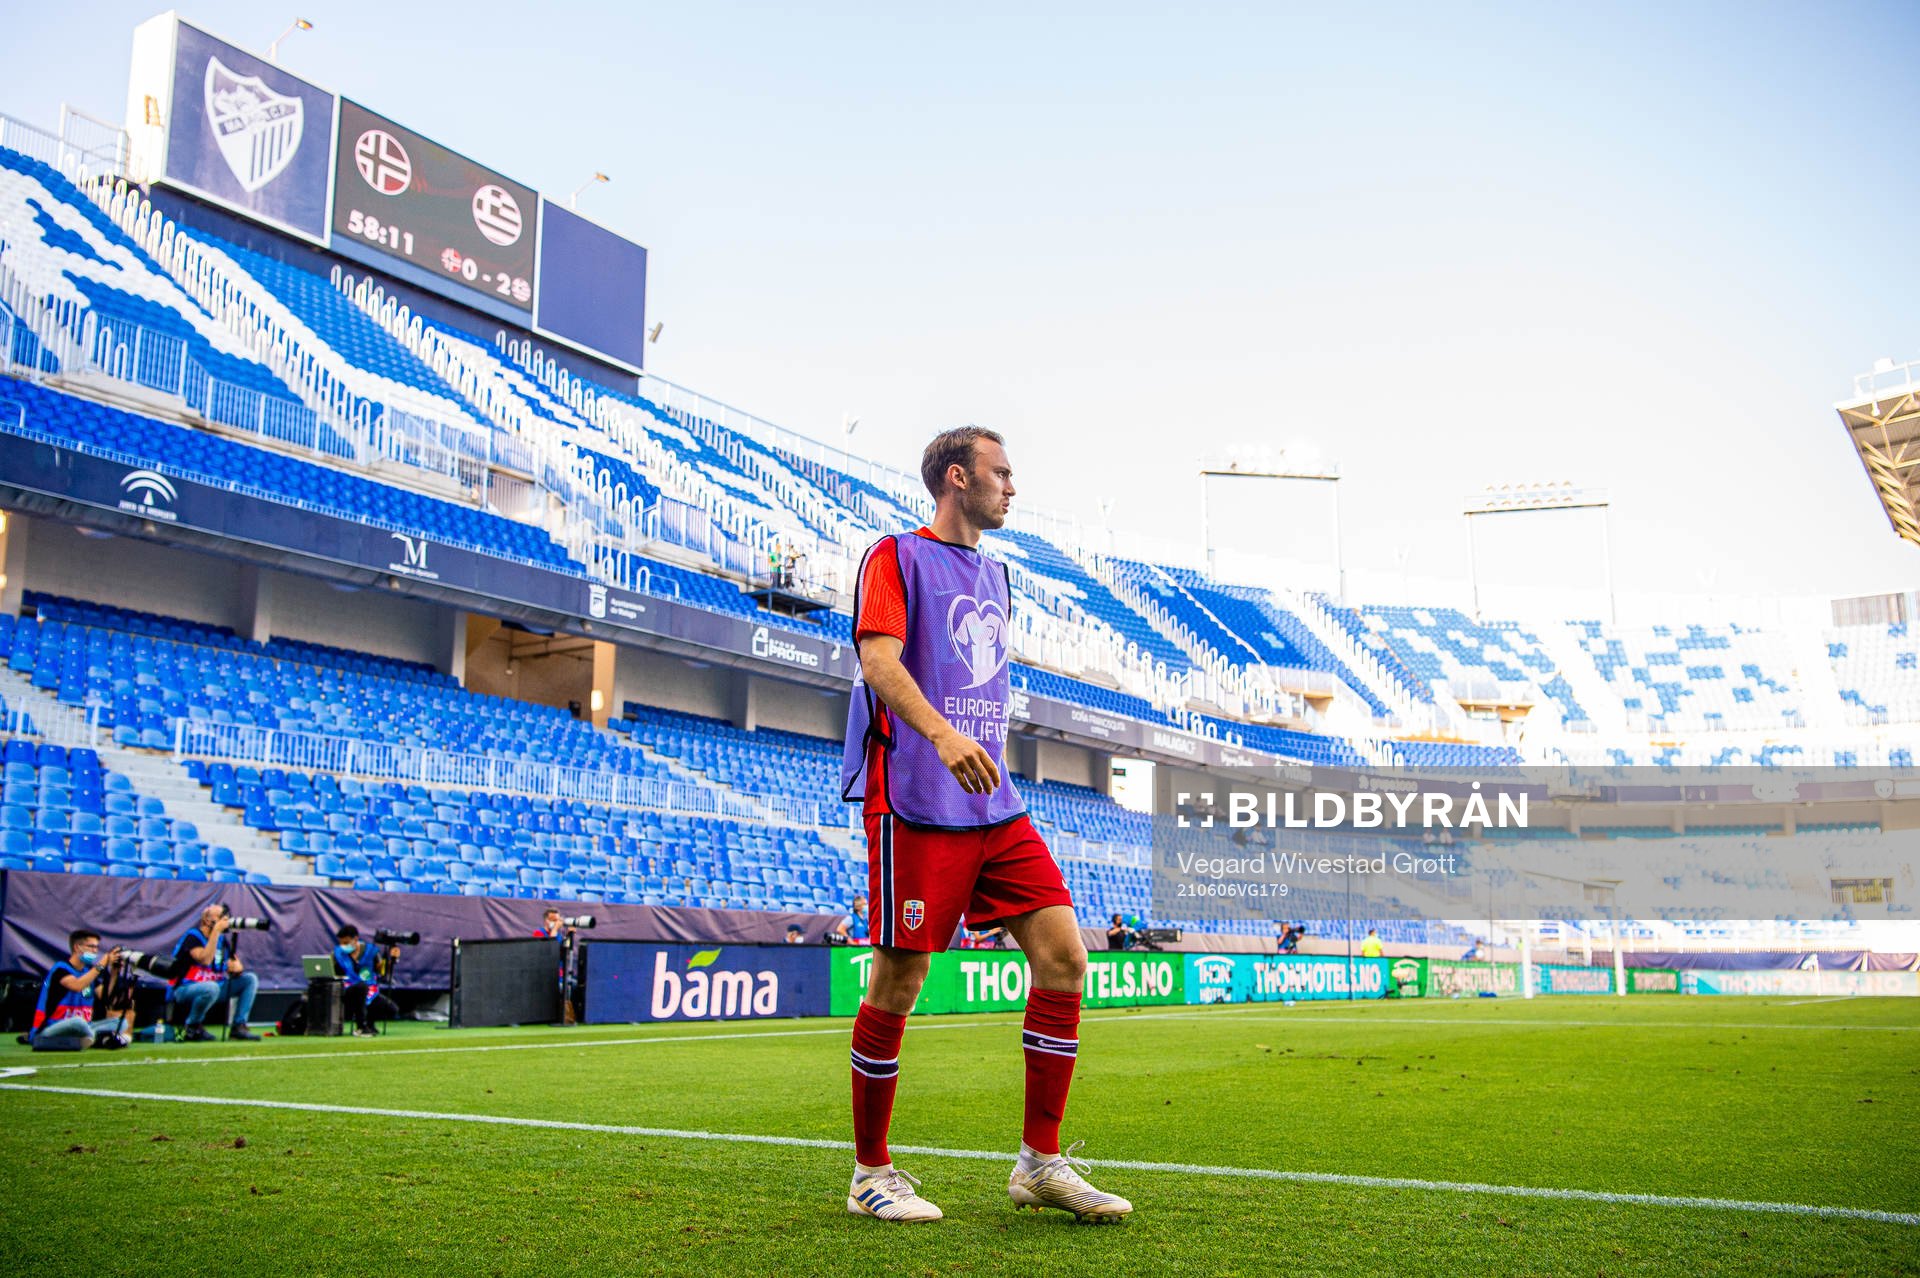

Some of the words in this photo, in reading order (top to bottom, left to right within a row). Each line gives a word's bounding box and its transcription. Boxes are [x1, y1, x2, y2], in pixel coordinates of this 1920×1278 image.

[347, 209, 414, 255] 58:11
[462, 258, 478, 281] 0
[496, 272, 511, 296] 2
[769, 638, 818, 667] PROTEC
[651, 951, 779, 1019] bama
[960, 961, 1173, 1001] THOTELS.NO
